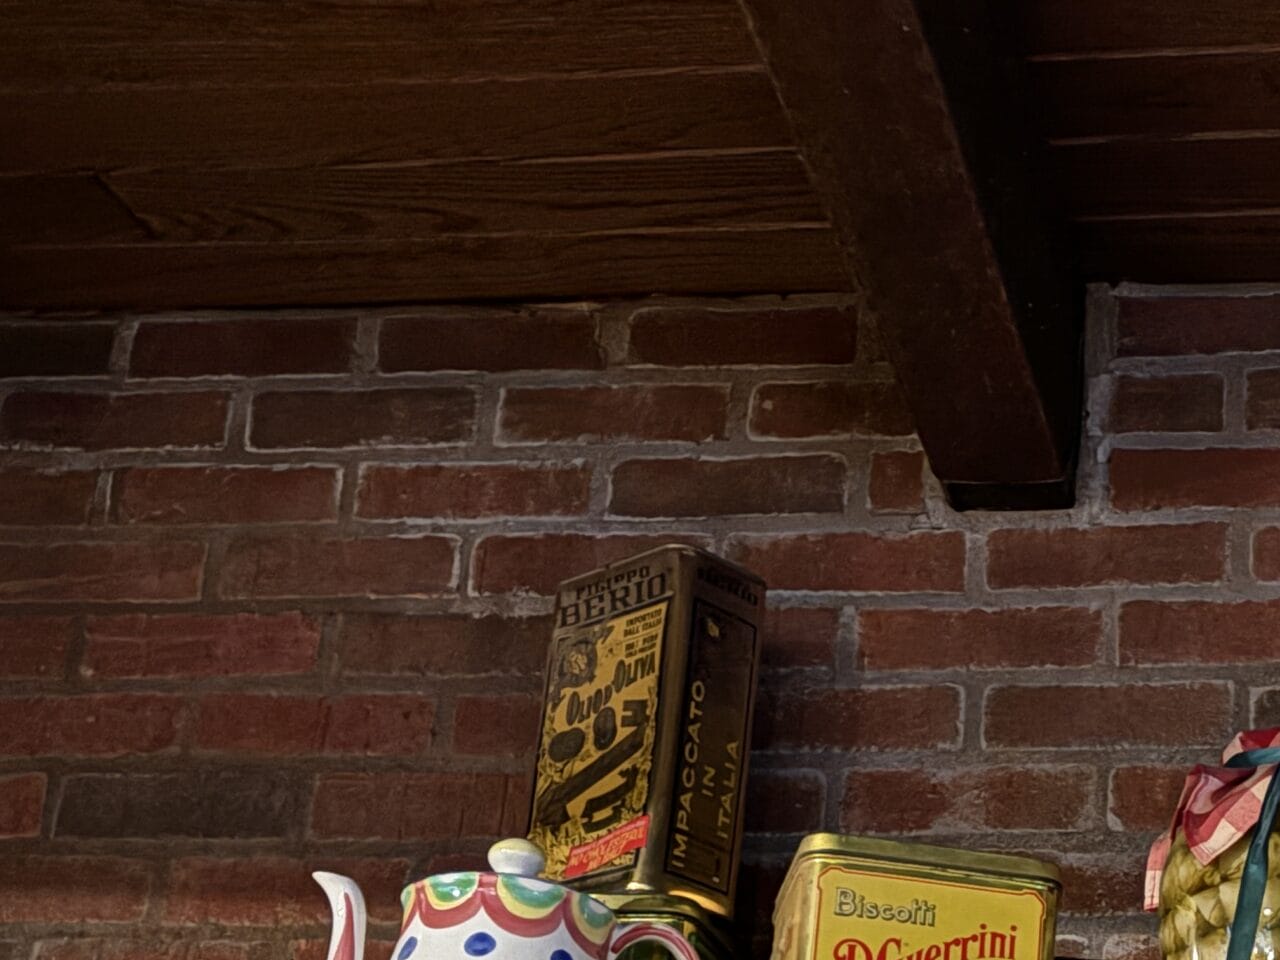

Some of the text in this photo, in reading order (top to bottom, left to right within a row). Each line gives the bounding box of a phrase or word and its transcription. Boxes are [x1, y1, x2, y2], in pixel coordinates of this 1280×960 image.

[561, 572, 668, 627] BERIO
[576, 566, 651, 599] FILIPPO
[566, 688, 603, 726] OLIO
[671, 680, 706, 868] IMPACCATO
[701, 766, 717, 797] IN
[716, 741, 740, 839] ITALIA
[834, 886, 936, 927] Biscotti
